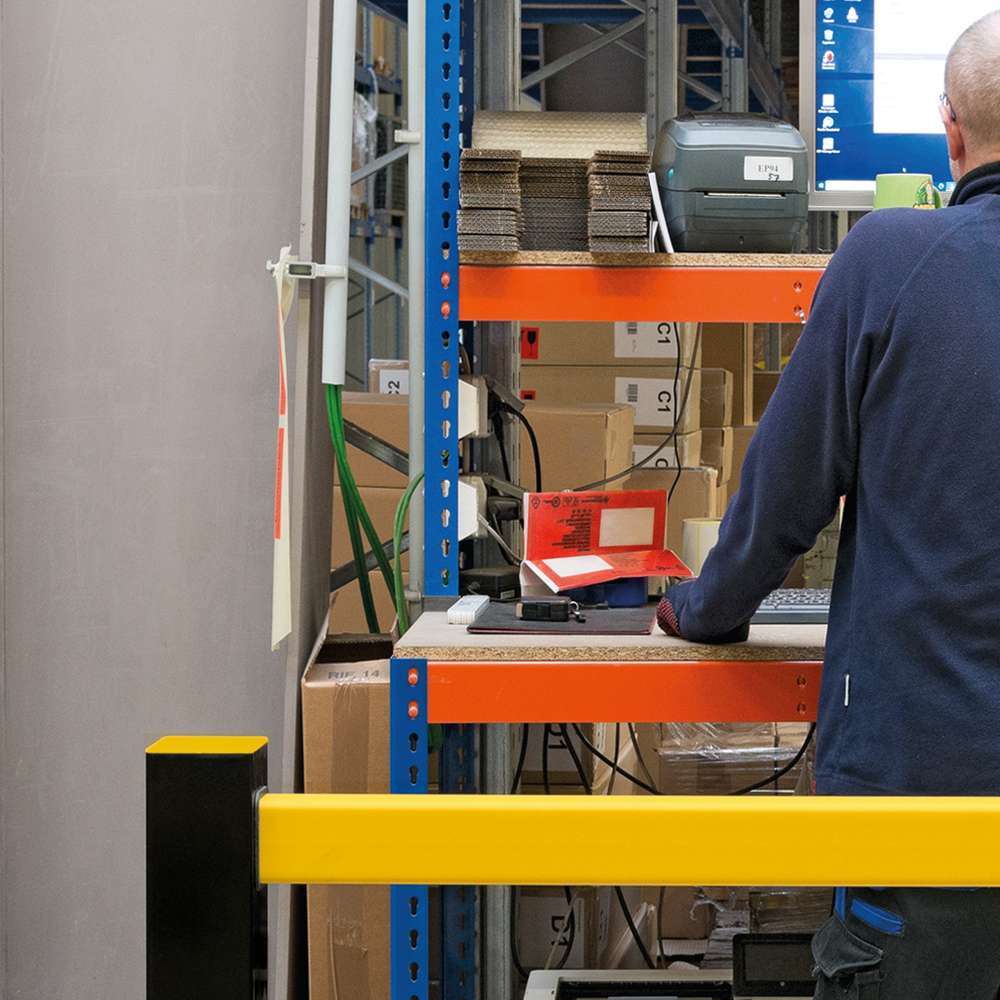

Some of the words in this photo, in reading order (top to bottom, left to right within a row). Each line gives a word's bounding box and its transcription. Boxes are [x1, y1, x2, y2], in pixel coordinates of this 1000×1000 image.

[657, 322, 671, 344] C1
[387, 380, 400, 394] 2
[657, 390, 671, 413] C1
